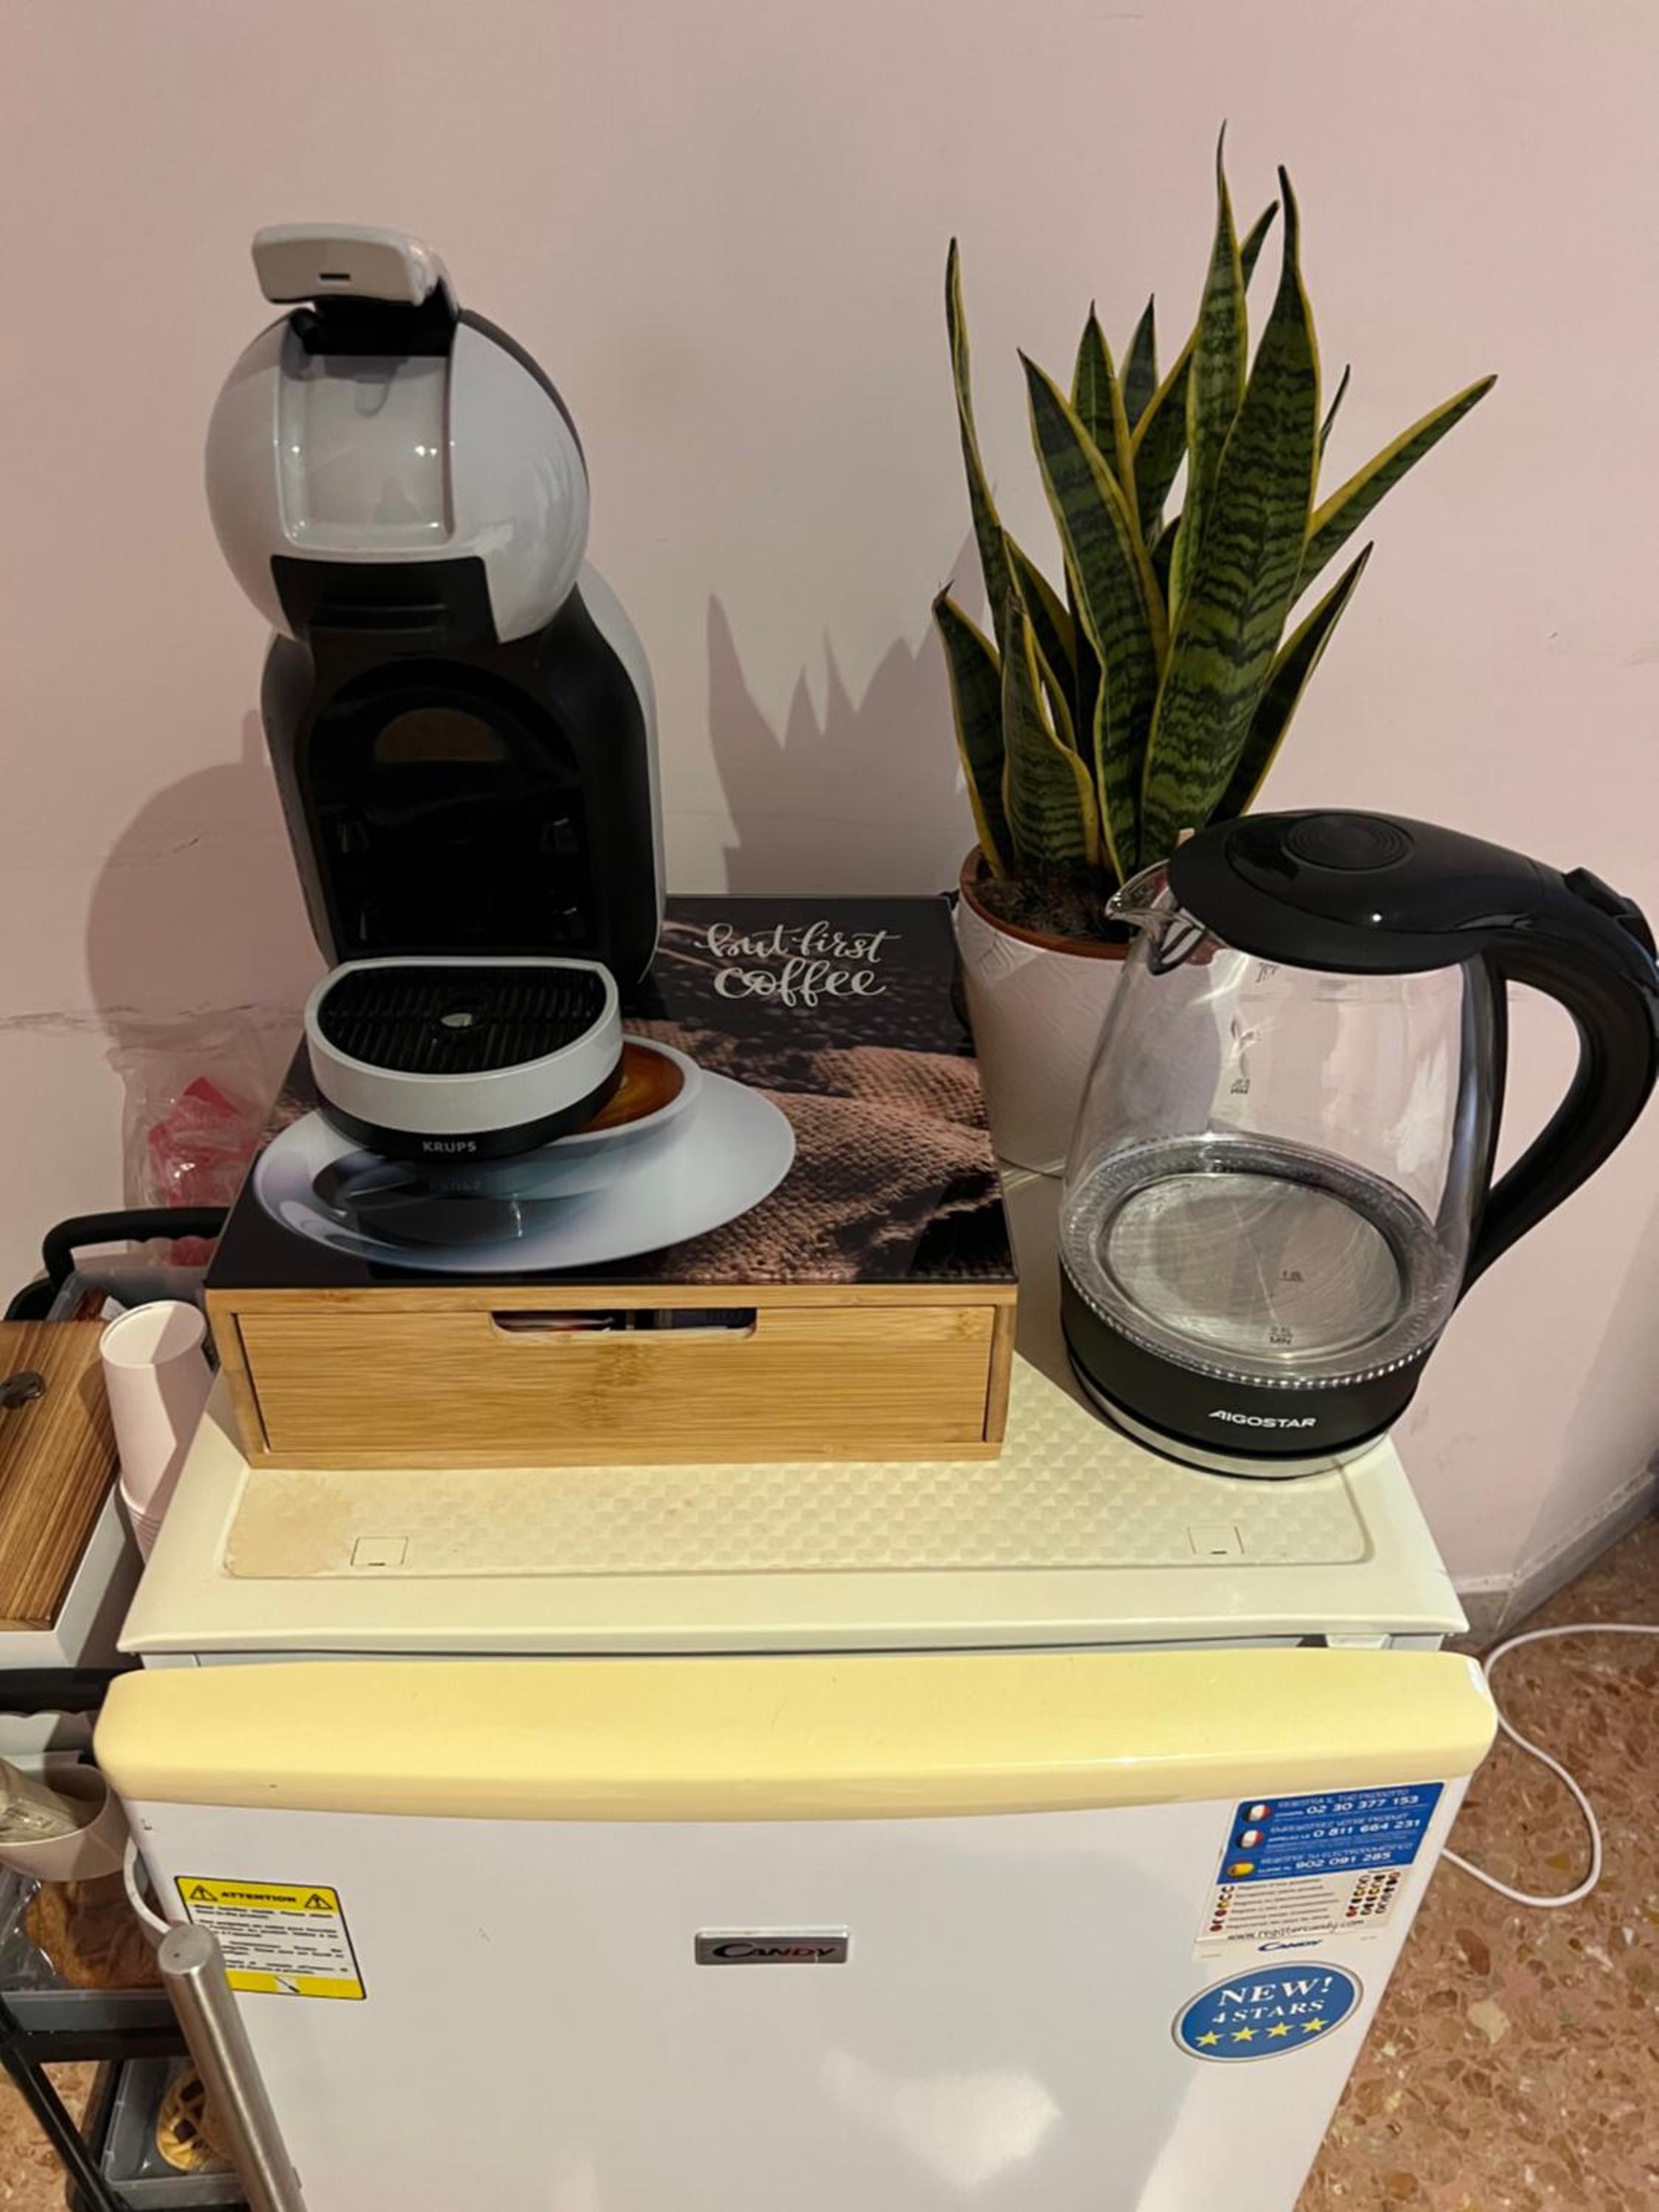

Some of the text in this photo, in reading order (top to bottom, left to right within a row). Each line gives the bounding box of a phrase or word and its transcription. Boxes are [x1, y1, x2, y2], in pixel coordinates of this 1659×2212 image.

[694, 921, 901, 963] but first
[714, 957, 886, 1006] coffee
[422, 1141, 477, 1152] KRUPS
[1208, 1410, 1316, 1427] AIGOSTAR
[1306, 1804, 1327, 1815] 02
[1333, 1802, 1353, 1812] 30
[1357, 1798, 1386, 1809] 377
[1392, 1795, 1419, 1806] 153
[1313, 1829, 1324, 1839] 0
[1328, 1826, 1354, 1837] 811
[1360, 1822, 1389, 1833] 664
[1394, 1818, 1421, 1829] 231
[1295, 1858, 1325, 1869] 902
[1329, 1855, 1356, 1866] 091
[1362, 1851, 1391, 1863] 285
[221, 1891, 296, 1903] ATTENTION
[1218, 1977, 1333, 2006] NEW!
[1212, 1999, 1325, 2023] 4 STARS
